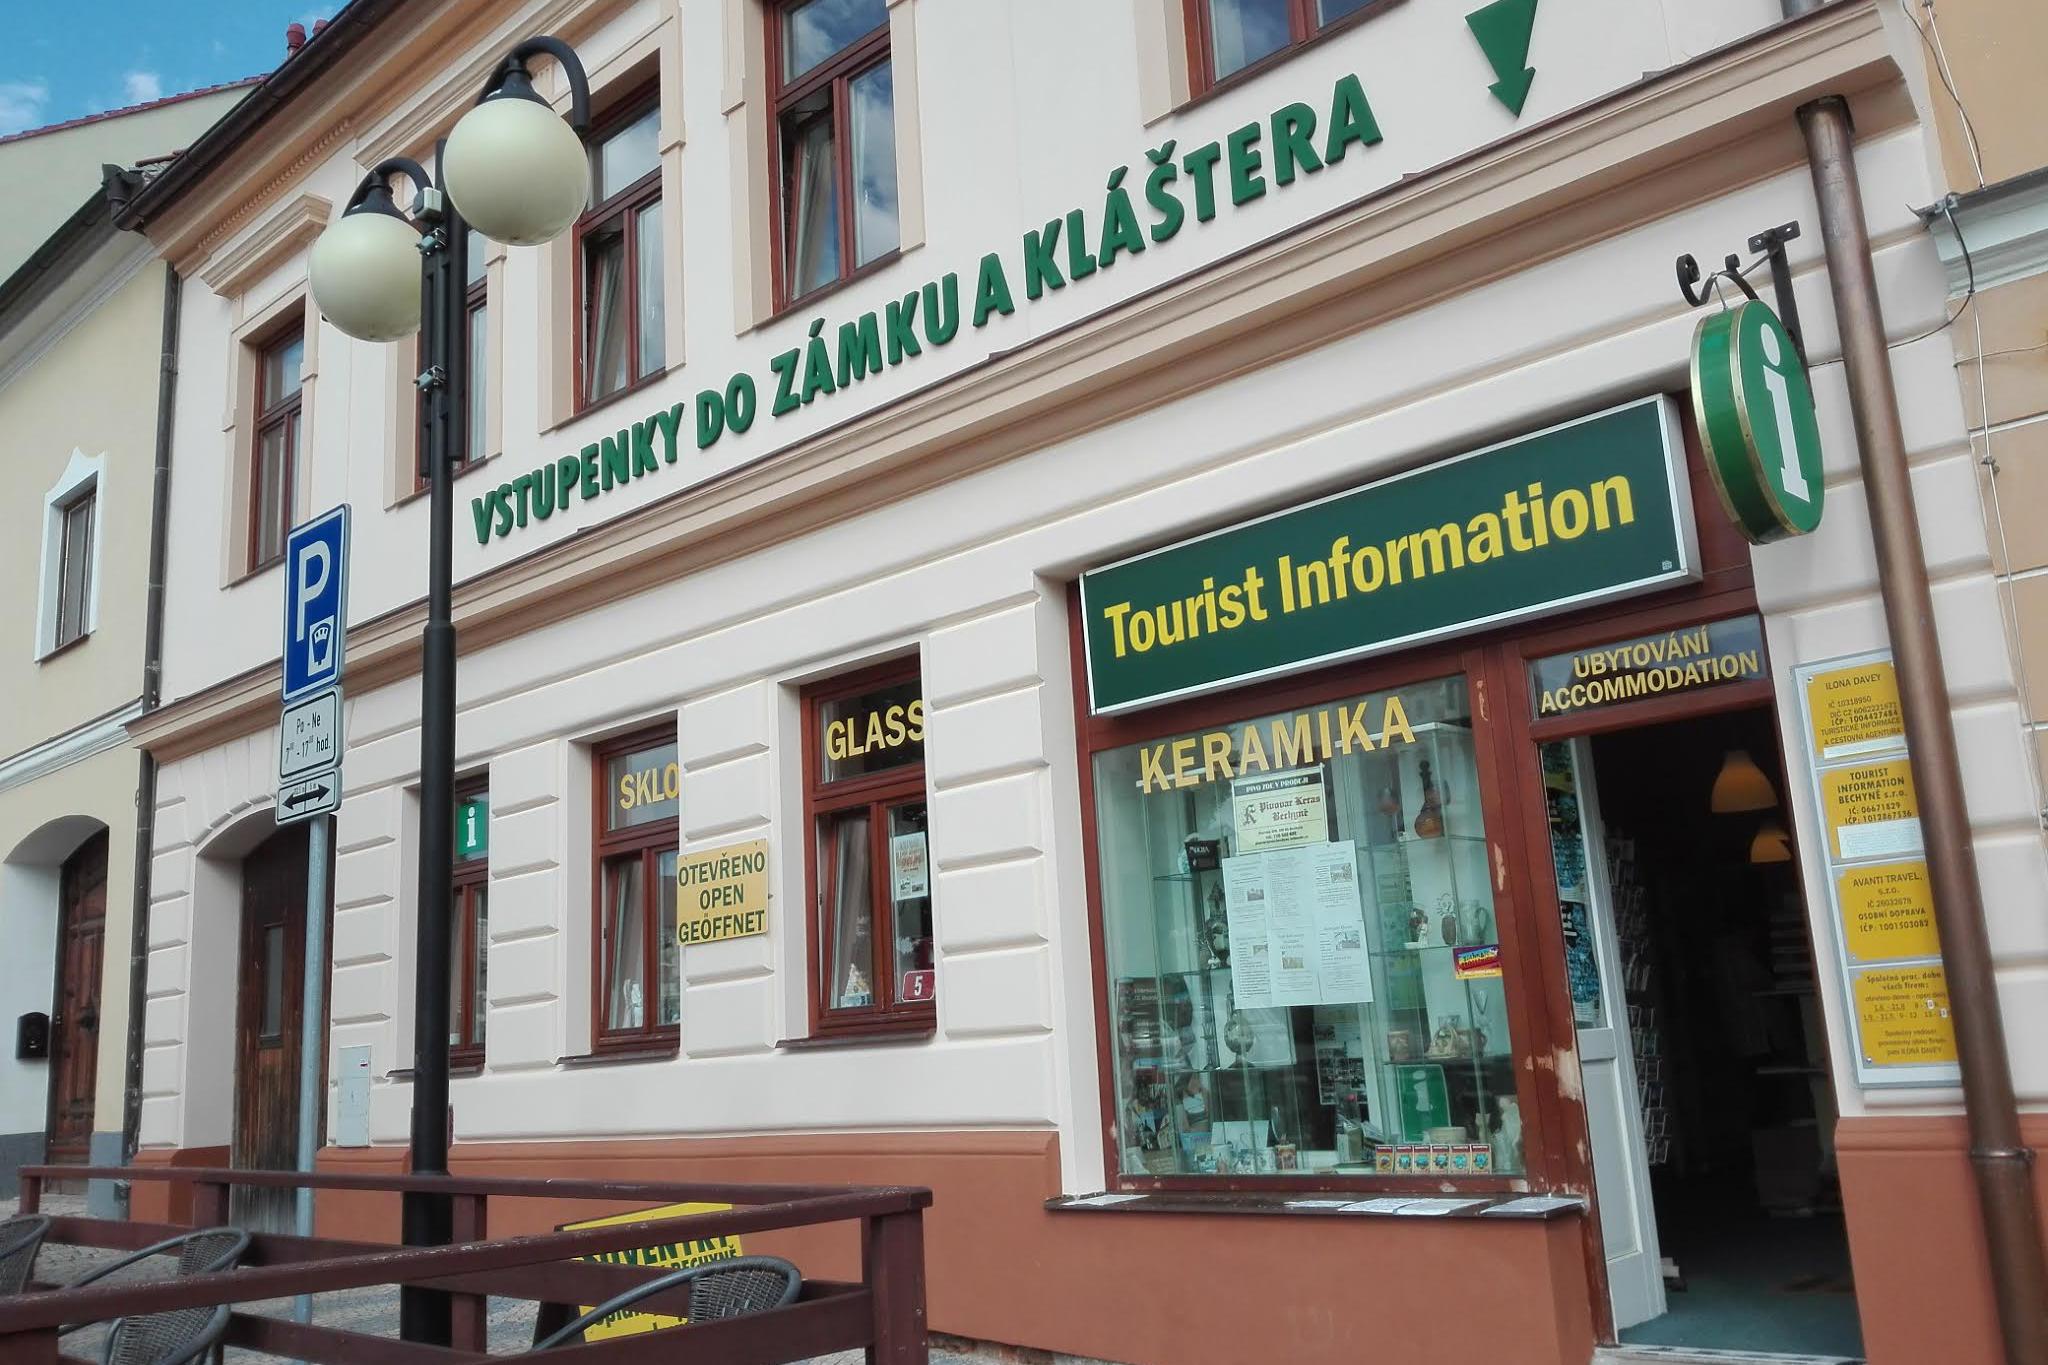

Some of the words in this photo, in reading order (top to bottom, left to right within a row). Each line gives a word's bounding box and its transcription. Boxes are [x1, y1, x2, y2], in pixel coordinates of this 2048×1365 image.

[471, 402, 685, 544] VSTUPENKY
[696, 372, 756, 449] DO
[771, 272, 959, 417] ZÁMKU
[972, 252, 1015, 328] A
[1023, 73, 1384, 300] KLÁŠTERA
[1103, 566, 1269, 659] Tourist
[1277, 474, 1635, 614] Information
[296, 540, 331, 642] P
[1573, 624, 1710, 678] UBYTOVÁNÍ
[1541, 650, 1759, 713] ACCOMMODATION
[1825, 679, 1851, 690] ILONA
[1854, 673, 1881, 685] DAVEY
[312, 712, 320, 728] Ne
[826, 699, 924, 760] GLASS
[316, 733, 331, 753] hod.
[1140, 696, 1416, 794] KERAMIKA
[620, 762, 680, 809] SKLO
[1837, 776, 1904, 793] INFORMATION
[1850, 768, 1888, 781] TOURIST
[678, 851, 765, 887] OTEVŘENO
[1853, 876, 1883, 887] AVANTI
[699, 883, 744, 910] OPEN
[1889, 907, 1926, 918] DOPRAVA
[678, 909, 765, 943] GEÖFFNET
[914, 975, 923, 996] 5
